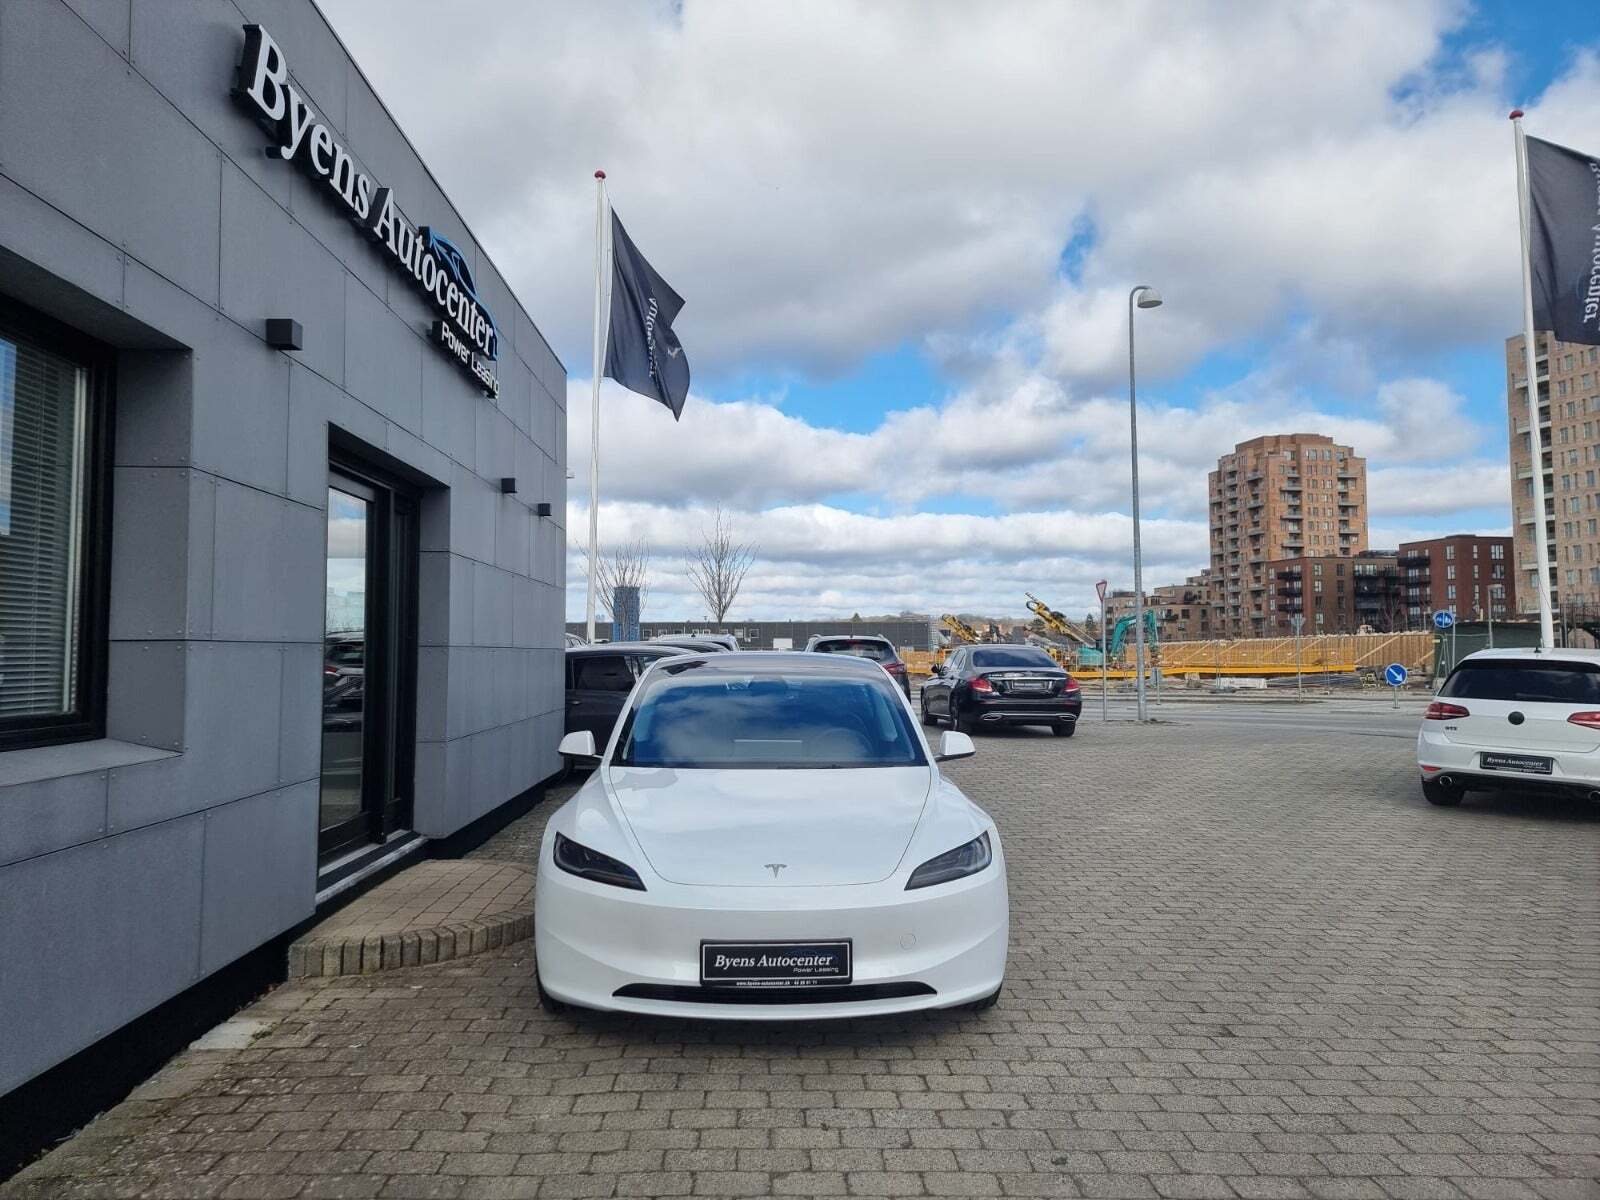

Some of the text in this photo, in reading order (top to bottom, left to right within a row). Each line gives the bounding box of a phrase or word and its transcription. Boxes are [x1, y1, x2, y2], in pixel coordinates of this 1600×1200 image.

[246, 24, 495, 358] Byens Autocenter
[441, 321, 500, 399] Power Leasing
[715, 954, 833, 970] Byens Autocenter
